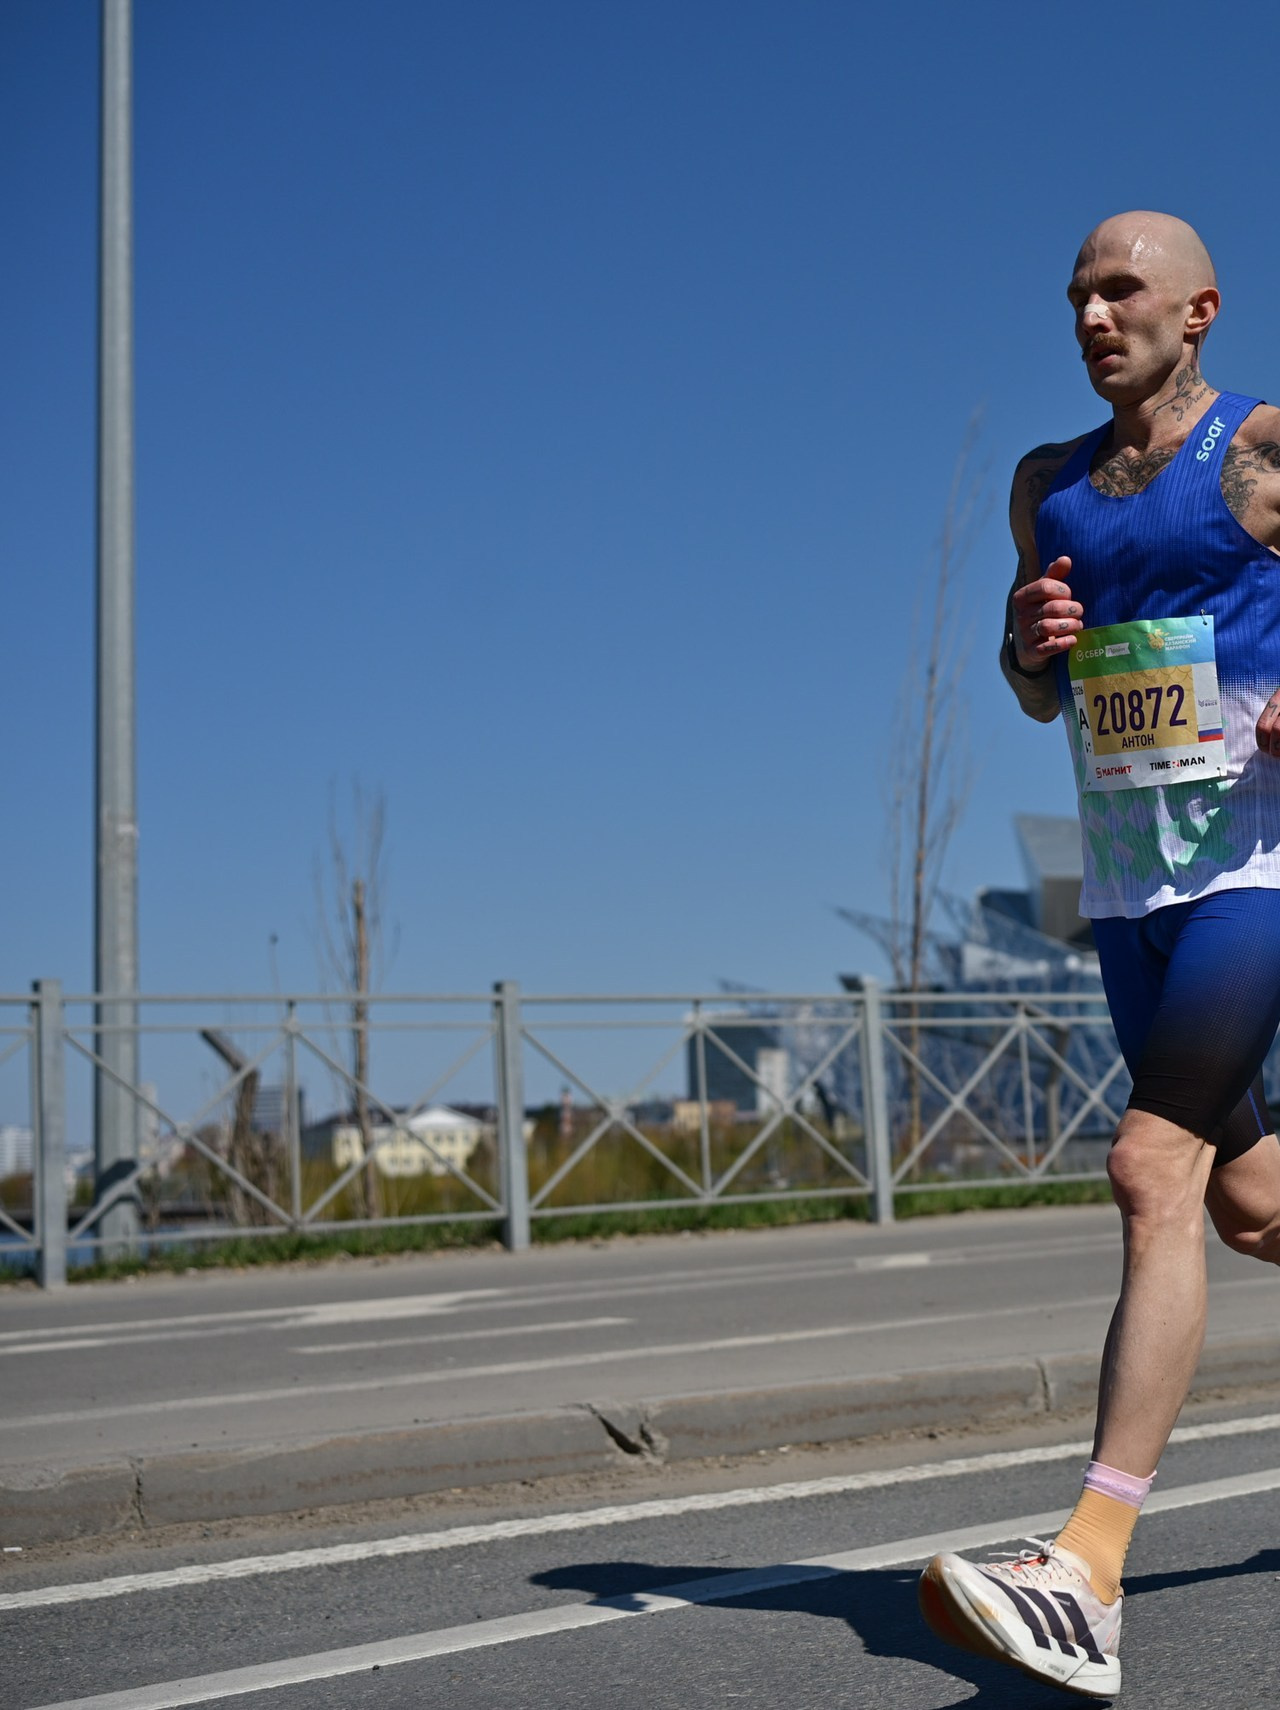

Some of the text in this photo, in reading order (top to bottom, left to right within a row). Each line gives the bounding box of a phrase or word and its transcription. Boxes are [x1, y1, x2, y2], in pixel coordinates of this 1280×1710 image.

[1196, 416, 1226, 462] soar
[1084, 648, 1105, 659] СБЕР
[1079, 708, 1090, 730] A
[1093, 684, 1188, 736] 20872
[1121, 733, 1155, 749] АНТОН
[1102, 765, 1133, 777] МАГНИТ
